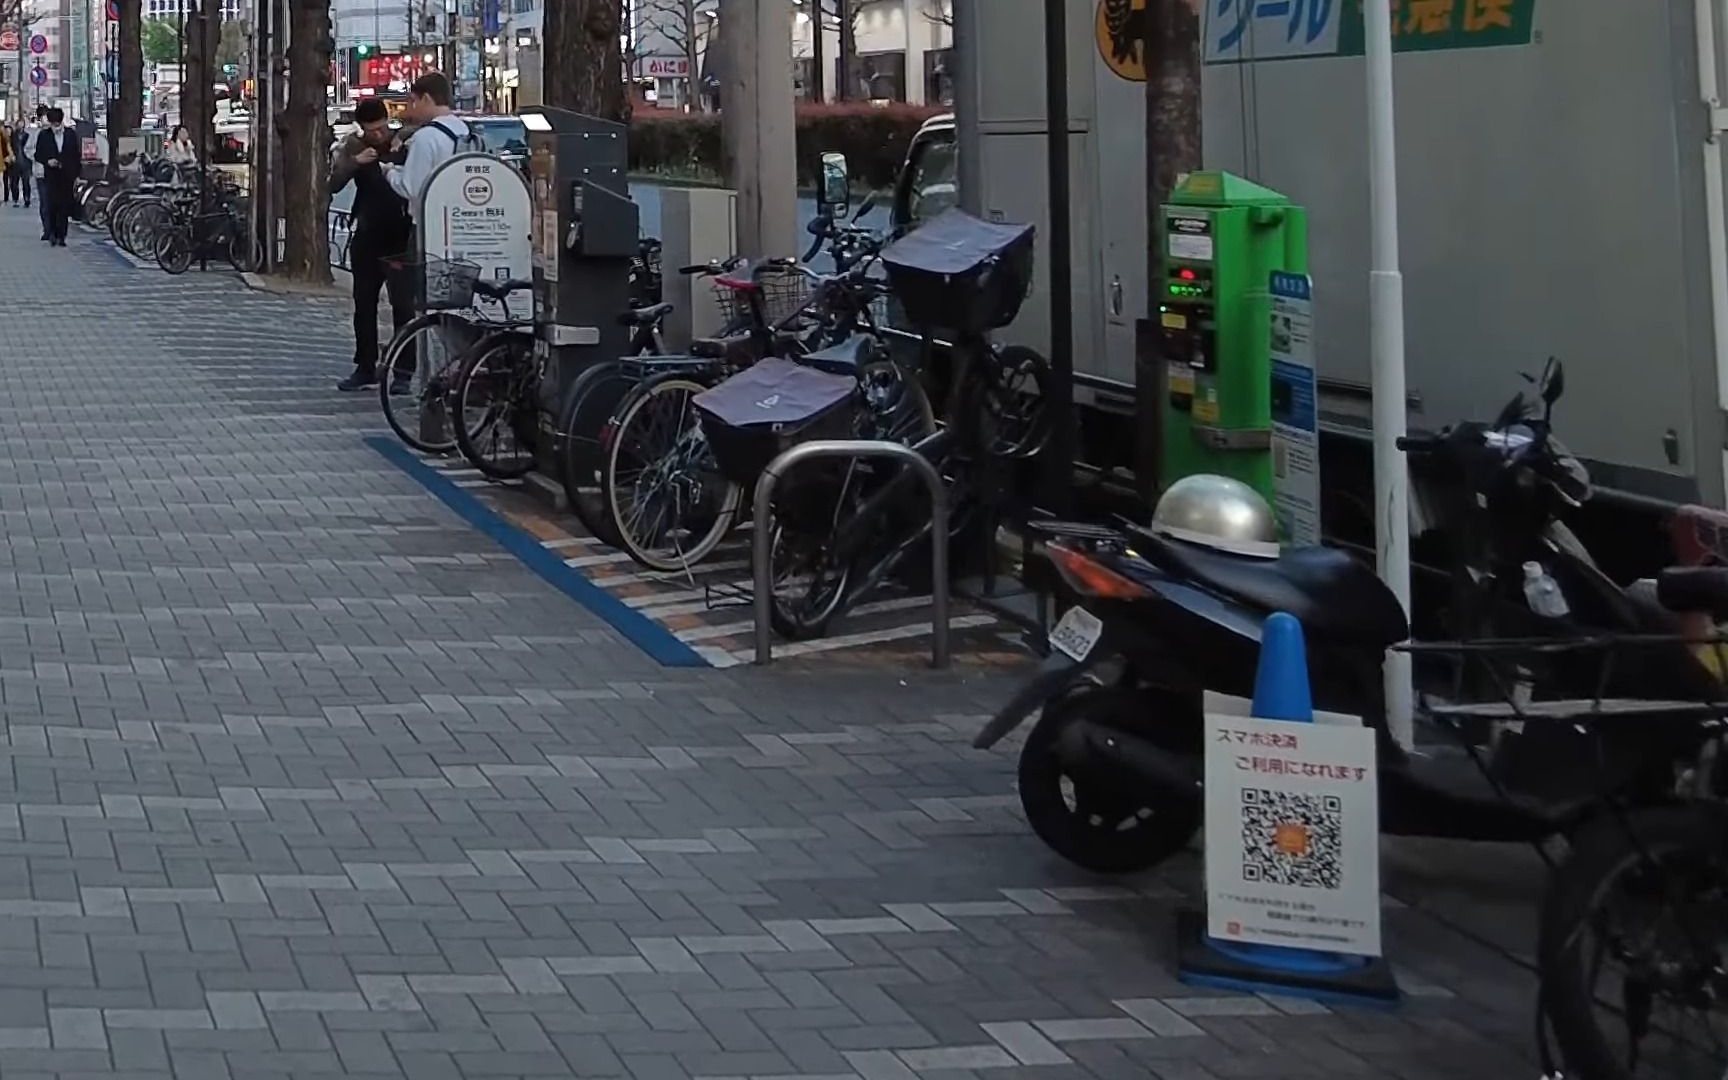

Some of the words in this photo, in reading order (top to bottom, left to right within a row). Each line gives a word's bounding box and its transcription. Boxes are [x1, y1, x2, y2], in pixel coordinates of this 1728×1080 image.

[1217, 728, 1298, 750] スマホ決済
[1235, 755, 1368, 781] ご利用になれます
